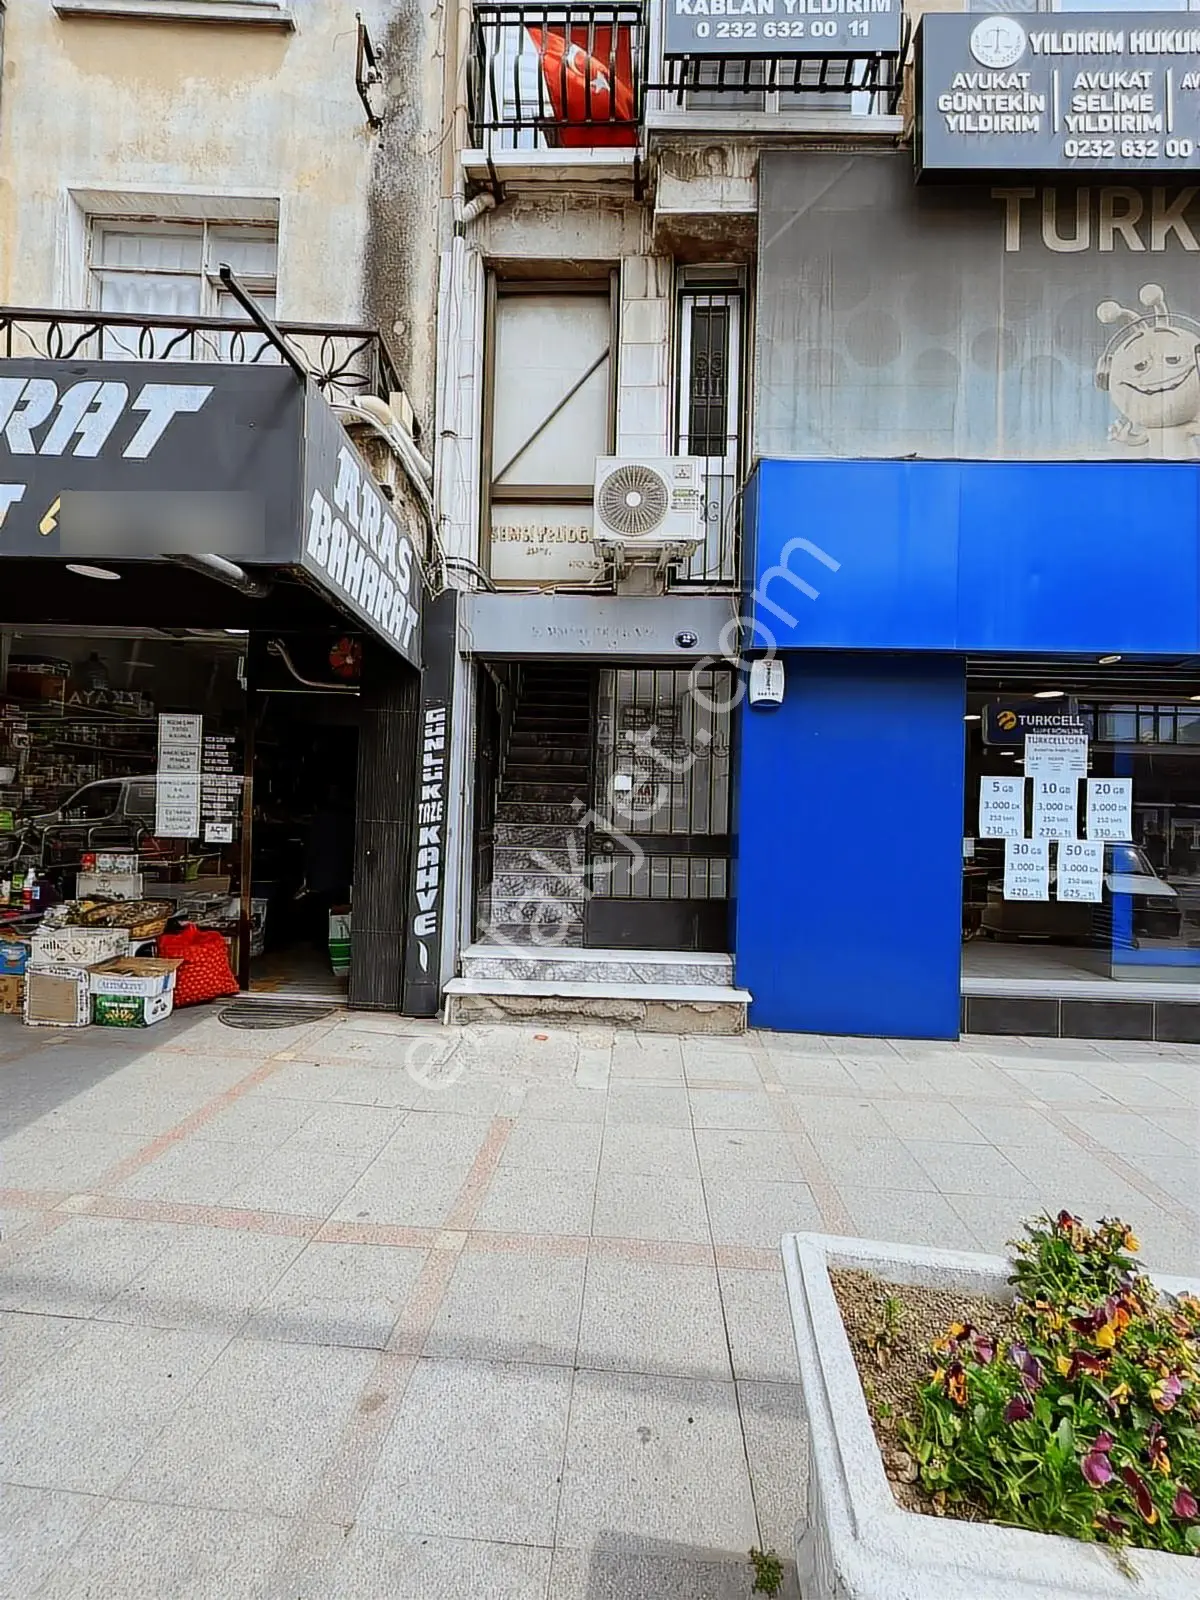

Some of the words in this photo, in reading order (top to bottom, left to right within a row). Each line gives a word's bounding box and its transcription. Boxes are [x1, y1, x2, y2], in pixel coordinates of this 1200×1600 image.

[783, 0, 891, 14] YILDIRIM
[697, 21, 710, 37] 0
[716, 21, 757, 38] 232
[763, 21, 804, 38] 632
[811, 20, 837, 37] 00
[848, 19, 870, 36] 11
[1029, 31, 1124, 55] YILDIRIM
[952, 72, 1031, 89] AVUKAT
[1073, 71, 1153, 90] AVUKAT
[938, 92, 1046, 113] GÜNTEKİN
[1072, 91, 1154, 113] SELİME
[944, 114, 1041, 133] YILDIRIM
[1064, 114, 1163, 134] YILDIRIM
[1064, 139, 1117, 158] 0232
[1121, 139, 1160, 158] 632
[1165, 138, 1194, 158] 00
[991, 182, 1200, 253] TURK
[333, 445, 413, 595] ARAS
[307, 488, 419, 649] BAHARAT
[1018, 715, 1084, 726] TURKCELL
[421, 707, 446, 801] GÜNLÜK
[992, 781, 1000, 793] 5
[1041, 783, 1057, 794] 10
[1095, 783, 1111, 795] 20
[417, 800, 443, 824] TAZE
[1012, 844, 1029, 855] 30
[1065, 845, 1082, 856] 50
[413, 825, 440, 937] KAHVE
